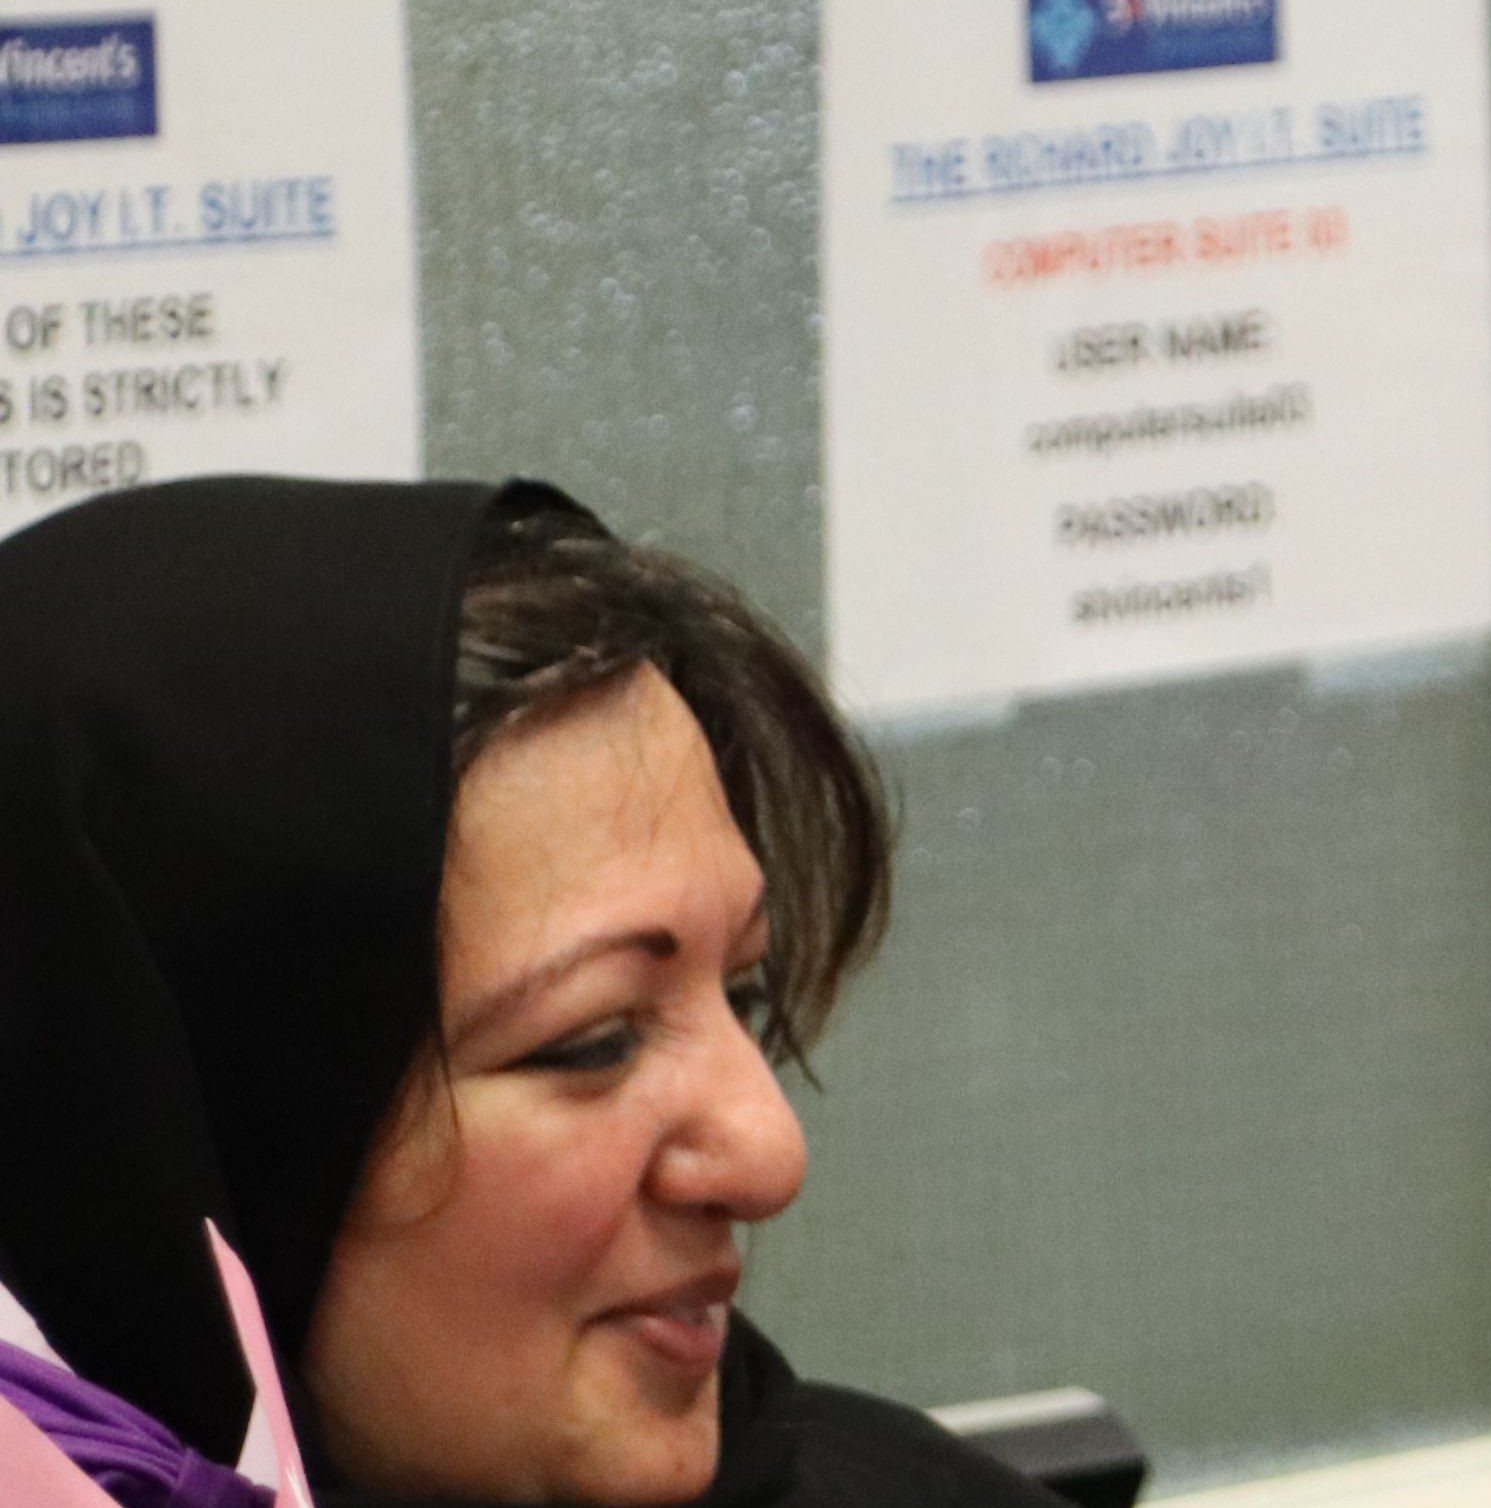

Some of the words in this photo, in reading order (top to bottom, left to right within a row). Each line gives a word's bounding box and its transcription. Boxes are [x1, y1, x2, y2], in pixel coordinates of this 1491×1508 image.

[890, 138, 970, 192] THE
[983, 121, 1154, 184] RICHARD
[1315, 95, 1425, 151] SUITE
[16, 189, 103, 245] JOY
[200, 175, 333, 231] SUITE
[984, 222, 1183, 285] COMPUTER
[1193, 210, 1291, 261] SUITE
[5, 303, 64, 350] OF
[79, 292, 212, 345] THESE
[1052, 323, 1149, 371] USER
[1160, 309, 1267, 362] NAME
[30, 374, 68, 422] IS
[83, 356, 287, 415] STRICTLY
[1056, 480, 1275, 548] PASSWORD
